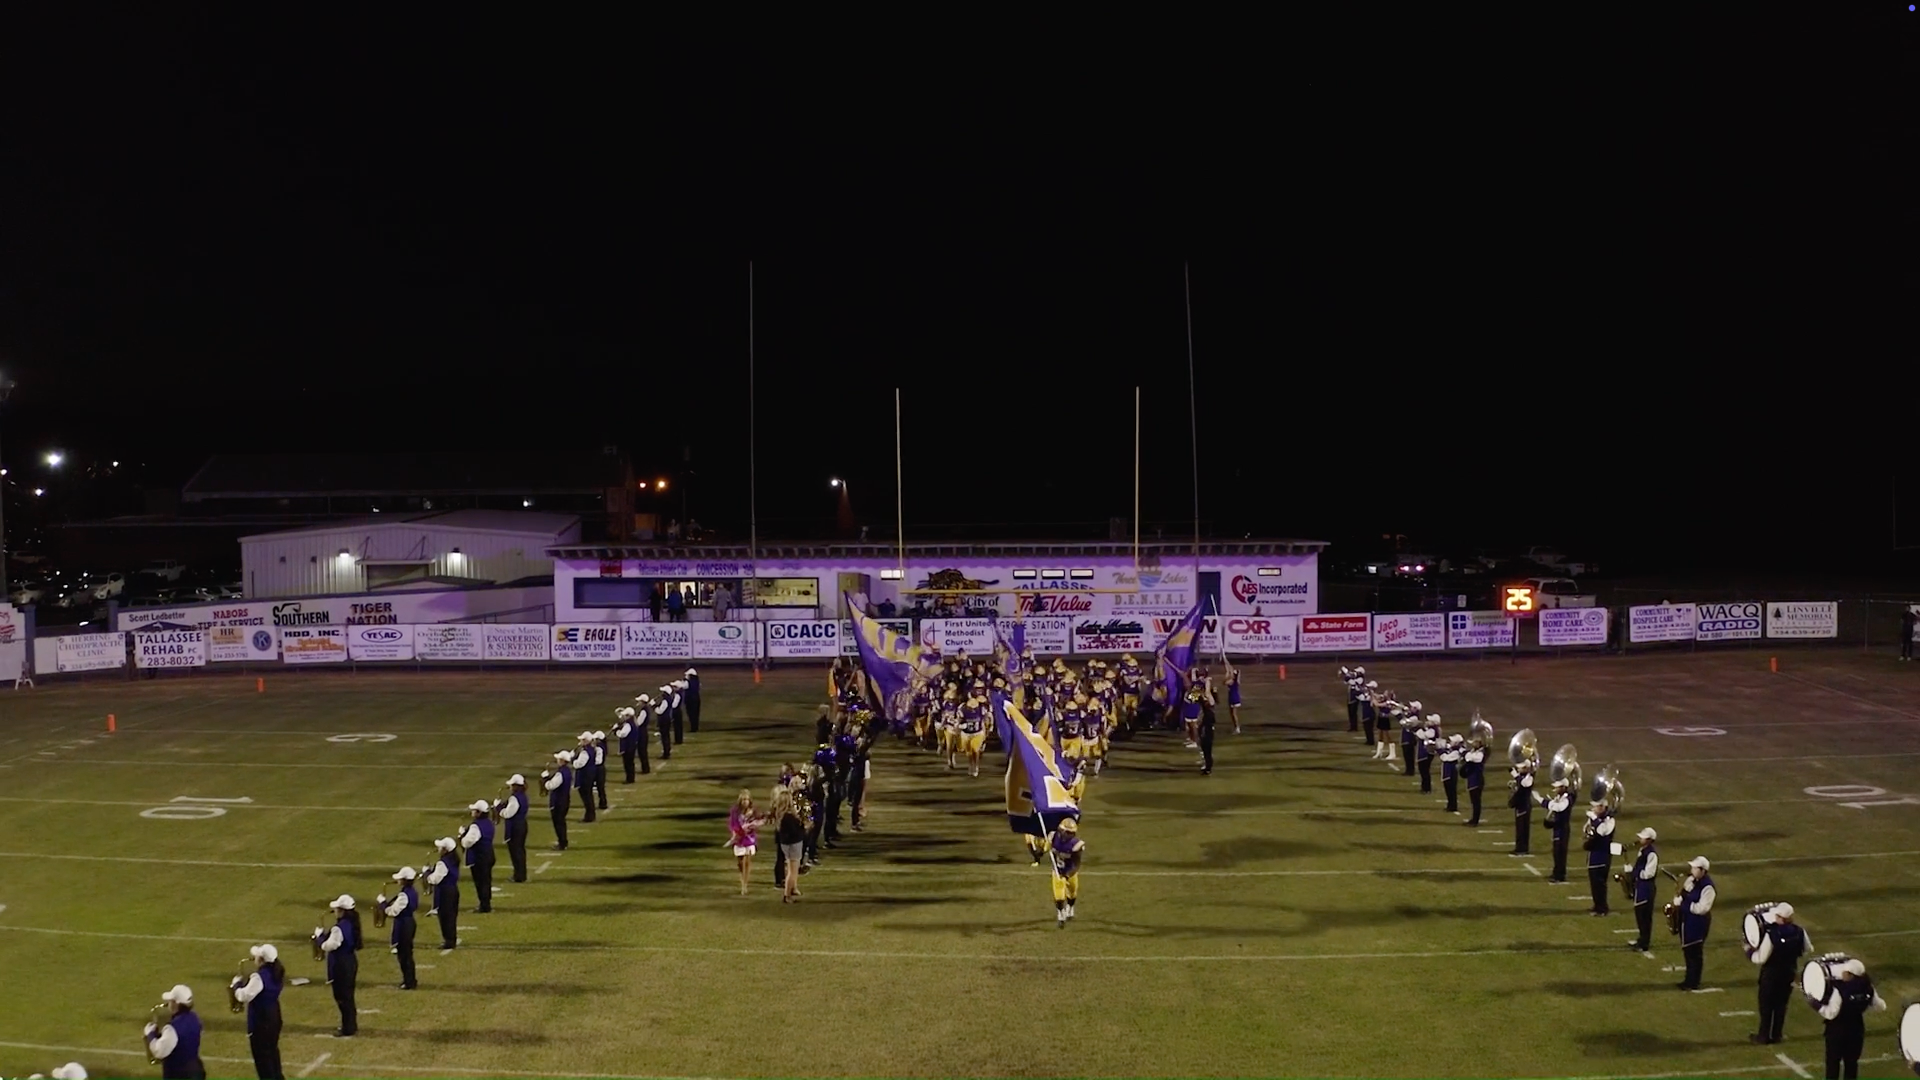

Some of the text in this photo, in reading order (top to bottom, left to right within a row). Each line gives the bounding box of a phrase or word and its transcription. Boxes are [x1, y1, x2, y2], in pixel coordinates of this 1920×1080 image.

[696, 563, 739, 575] CONCESSION
[1241, 582, 1308, 596] AES Incorporated
[967, 596, 999, 609] City of
[1019, 595, 1048, 612] Tre
[1048, 595, 1093, 613] Value
[1506, 588, 1532, 611] 25
[350, 602, 393, 614] TIGER
[1635, 607, 1670, 616] COMMUNITY
[1699, 604, 1759, 619] WACQ
[1787, 605, 1834, 613] LINVILLE
[129, 612, 186, 622] Scott Ledbetter
[213, 608, 249, 619] NABORS
[273, 605, 330, 626] SOUTHERN
[1545, 611, 1580, 620] COMMUNITY
[229, 616, 264, 627] SERVICE
[346, 614, 398, 625] NATION
[966, 620, 992, 628] United
[1542, 619, 1584, 628] HOME CARE
[1633, 614, 1674, 624] HOSPICE CARE
[1031, 620, 1066, 629] STATION
[1228, 619, 1271, 634] CXR
[1320, 620, 1364, 629] State Farm
[1377, 618, 1398, 634] Jaco
[1702, 620, 1756, 631] RADIO
[318, 629, 344, 637] INC.
[584, 628, 617, 641] EAGLE
[652, 630, 689, 638] CREEK
[787, 624, 836, 638] CACC
[945, 629, 985, 637] Methodist
[1384, 628, 1407, 643] Sales
[71, 634, 111, 643] HERRING
[138, 632, 203, 645] TALLASSEE
[487, 635, 544, 643] ENGINEERING
[945, 638, 974, 646] Church
[1302, 635, 1322, 643] Logan
[1348, 634, 1367, 643] Agent
[59, 640, 123, 651] CHIROPRACTIC
[143, 645, 184, 655] REHAB
[554, 643, 616, 652] CONVENIENT STORES
[77, 650, 107, 658] CLINIC
[147, 656, 195, 666] 283-8032
[139, 796, 254, 819] 10
